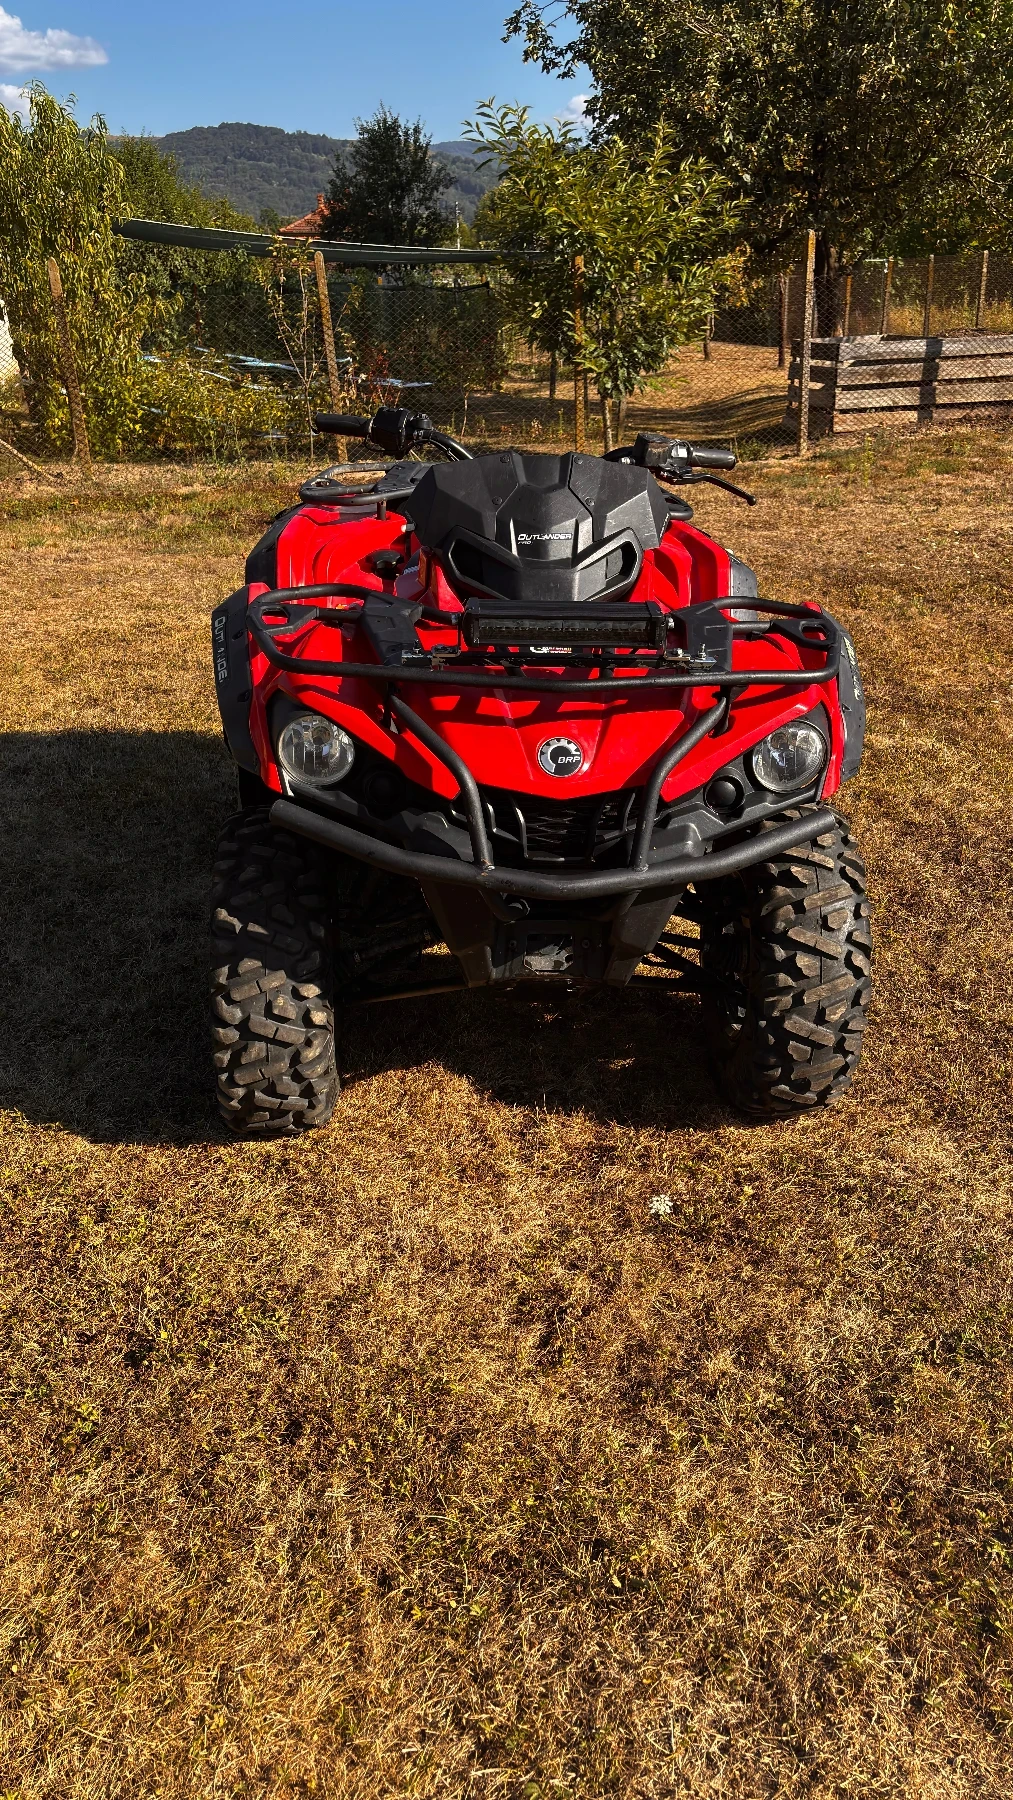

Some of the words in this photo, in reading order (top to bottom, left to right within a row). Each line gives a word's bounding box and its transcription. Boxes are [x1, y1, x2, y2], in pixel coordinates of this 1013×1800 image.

[517, 533, 572, 541] OUTLANDER
[214, 616, 228, 683] OUTANDE
[557, 755, 581, 764] BRP
